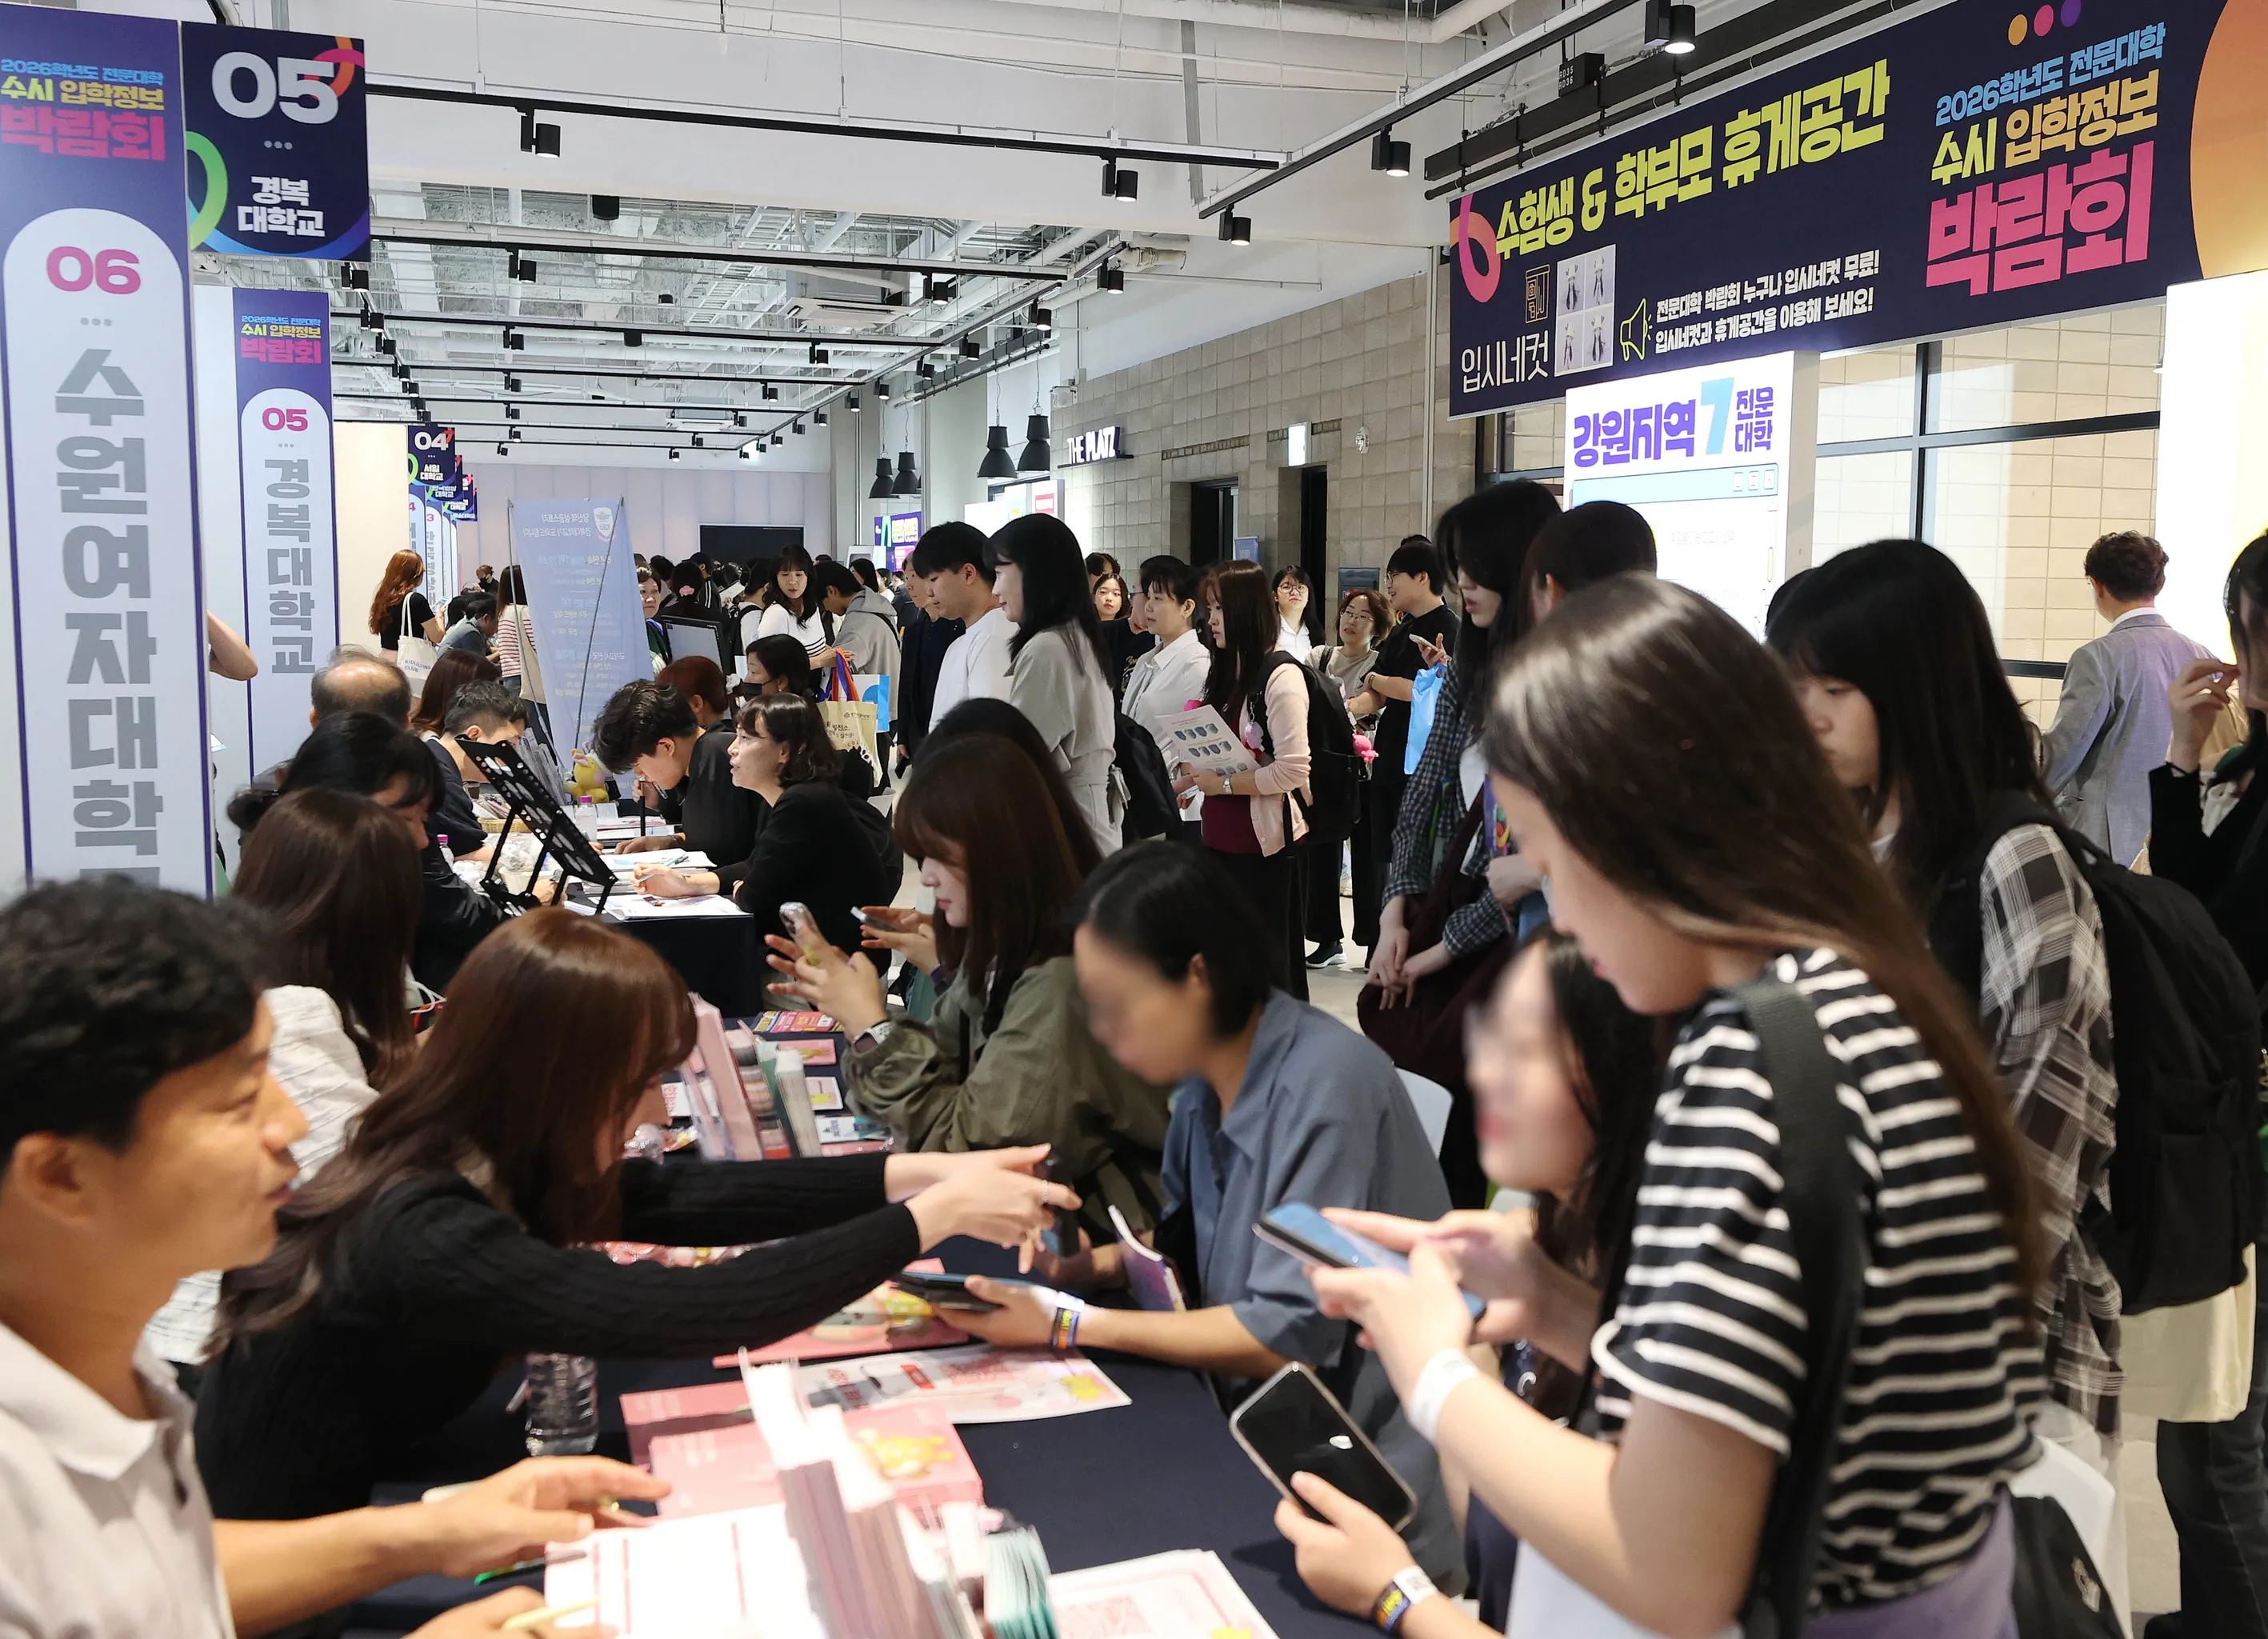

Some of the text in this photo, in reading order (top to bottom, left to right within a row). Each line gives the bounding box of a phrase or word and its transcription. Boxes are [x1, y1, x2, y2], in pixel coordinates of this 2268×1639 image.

[1, 58, 164, 85] 2026학년도 전문대학
[1, 77, 165, 110] 수시 입학정보
[211, 51, 339, 124] 05
[1936, 22, 2166, 126] 2026학년도 전문대학
[1, 106, 165, 161] 박람회
[1931, 69, 2159, 185] 수시 입학정보
[1496, 58, 1890, 259] 수험생 & 학부모 휴게공간
[250, 176, 310, 206] 경복
[237, 206, 326, 237] 대학교
[1926, 140, 2154, 297] 박람회
[46, 246, 142, 294] 06
[1656, 250, 1880, 322] 전문대학 박람회 누구나 입시네컷 무료!
[241, 324, 322, 338] 수시 입학정보
[1655, 287, 1874, 354] 입시네컷과 휴게공간을 이용해 보세요!
[241, 338, 322, 364] 박람회
[1462, 330, 1549, 393] 입시네컷
[262, 407, 308, 431] 05
[1574, 378, 1734, 468] 강원지역 7
[1736, 386, 1774, 421] 전문
[414, 432, 448, 450] 04
[1066, 435, 1085, 464] THE
[1734, 420, 1773, 452] 대학
[420, 472, 443, 481] 대학교
[265, 458, 316, 674] 경복대학교
[55, 349, 162, 881] 수원여자대학
